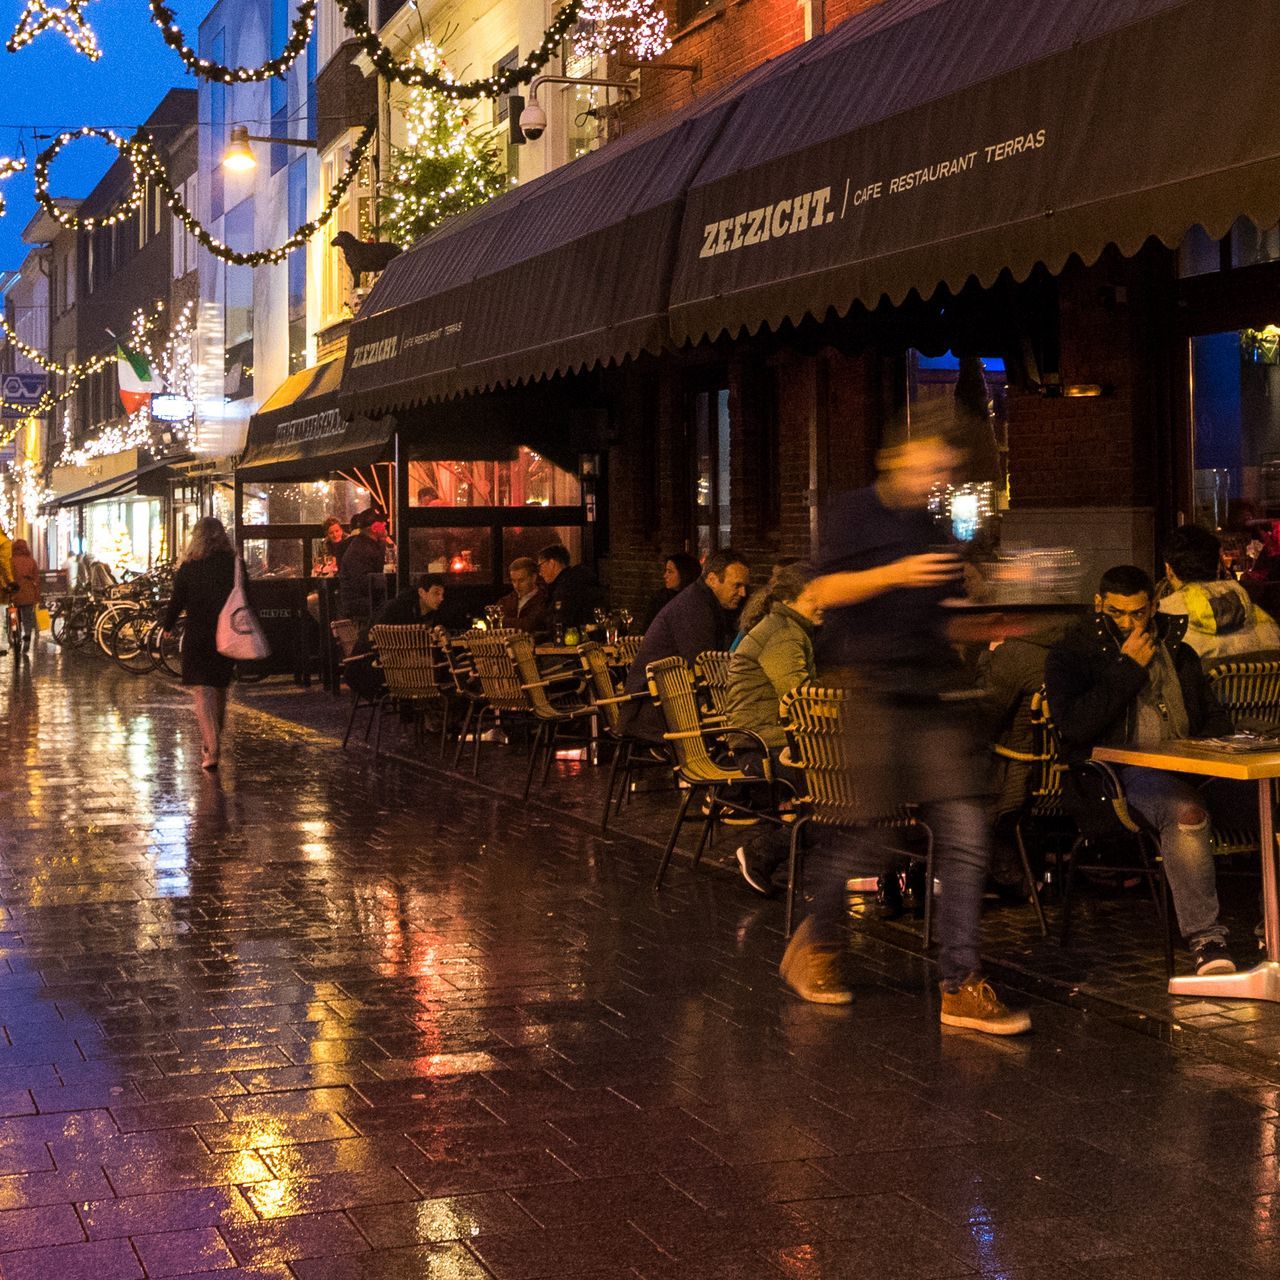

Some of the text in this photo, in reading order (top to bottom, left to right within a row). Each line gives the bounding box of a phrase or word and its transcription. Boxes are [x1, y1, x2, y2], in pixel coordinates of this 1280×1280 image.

[853, 181, 883, 207] CAFE
[889, 151, 978, 195] RESTAURANT
[985, 129, 1047, 164] TERRAS
